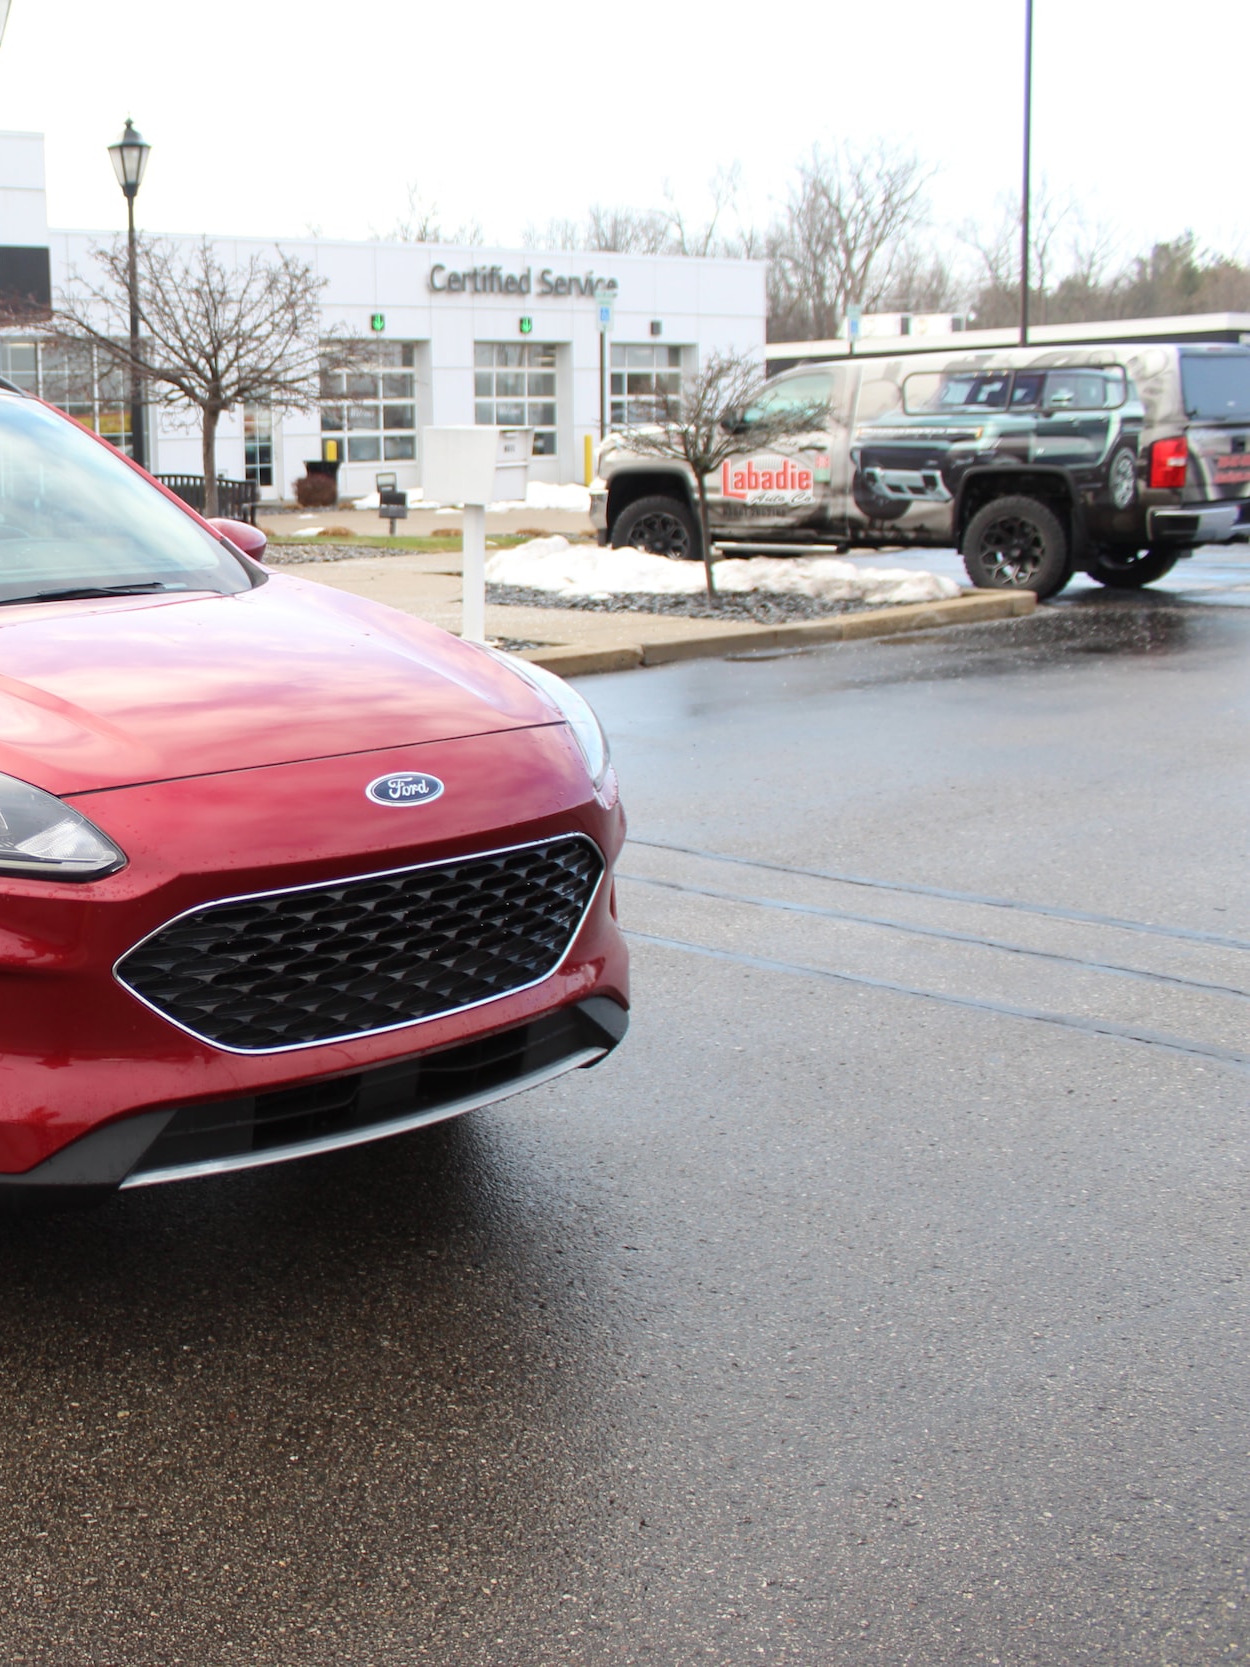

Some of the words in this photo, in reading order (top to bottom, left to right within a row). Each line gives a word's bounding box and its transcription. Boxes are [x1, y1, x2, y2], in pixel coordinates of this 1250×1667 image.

[430, 263, 531, 295] Certified
[722, 459, 812, 500] Labadie
[387, 776, 430, 799] Ford
